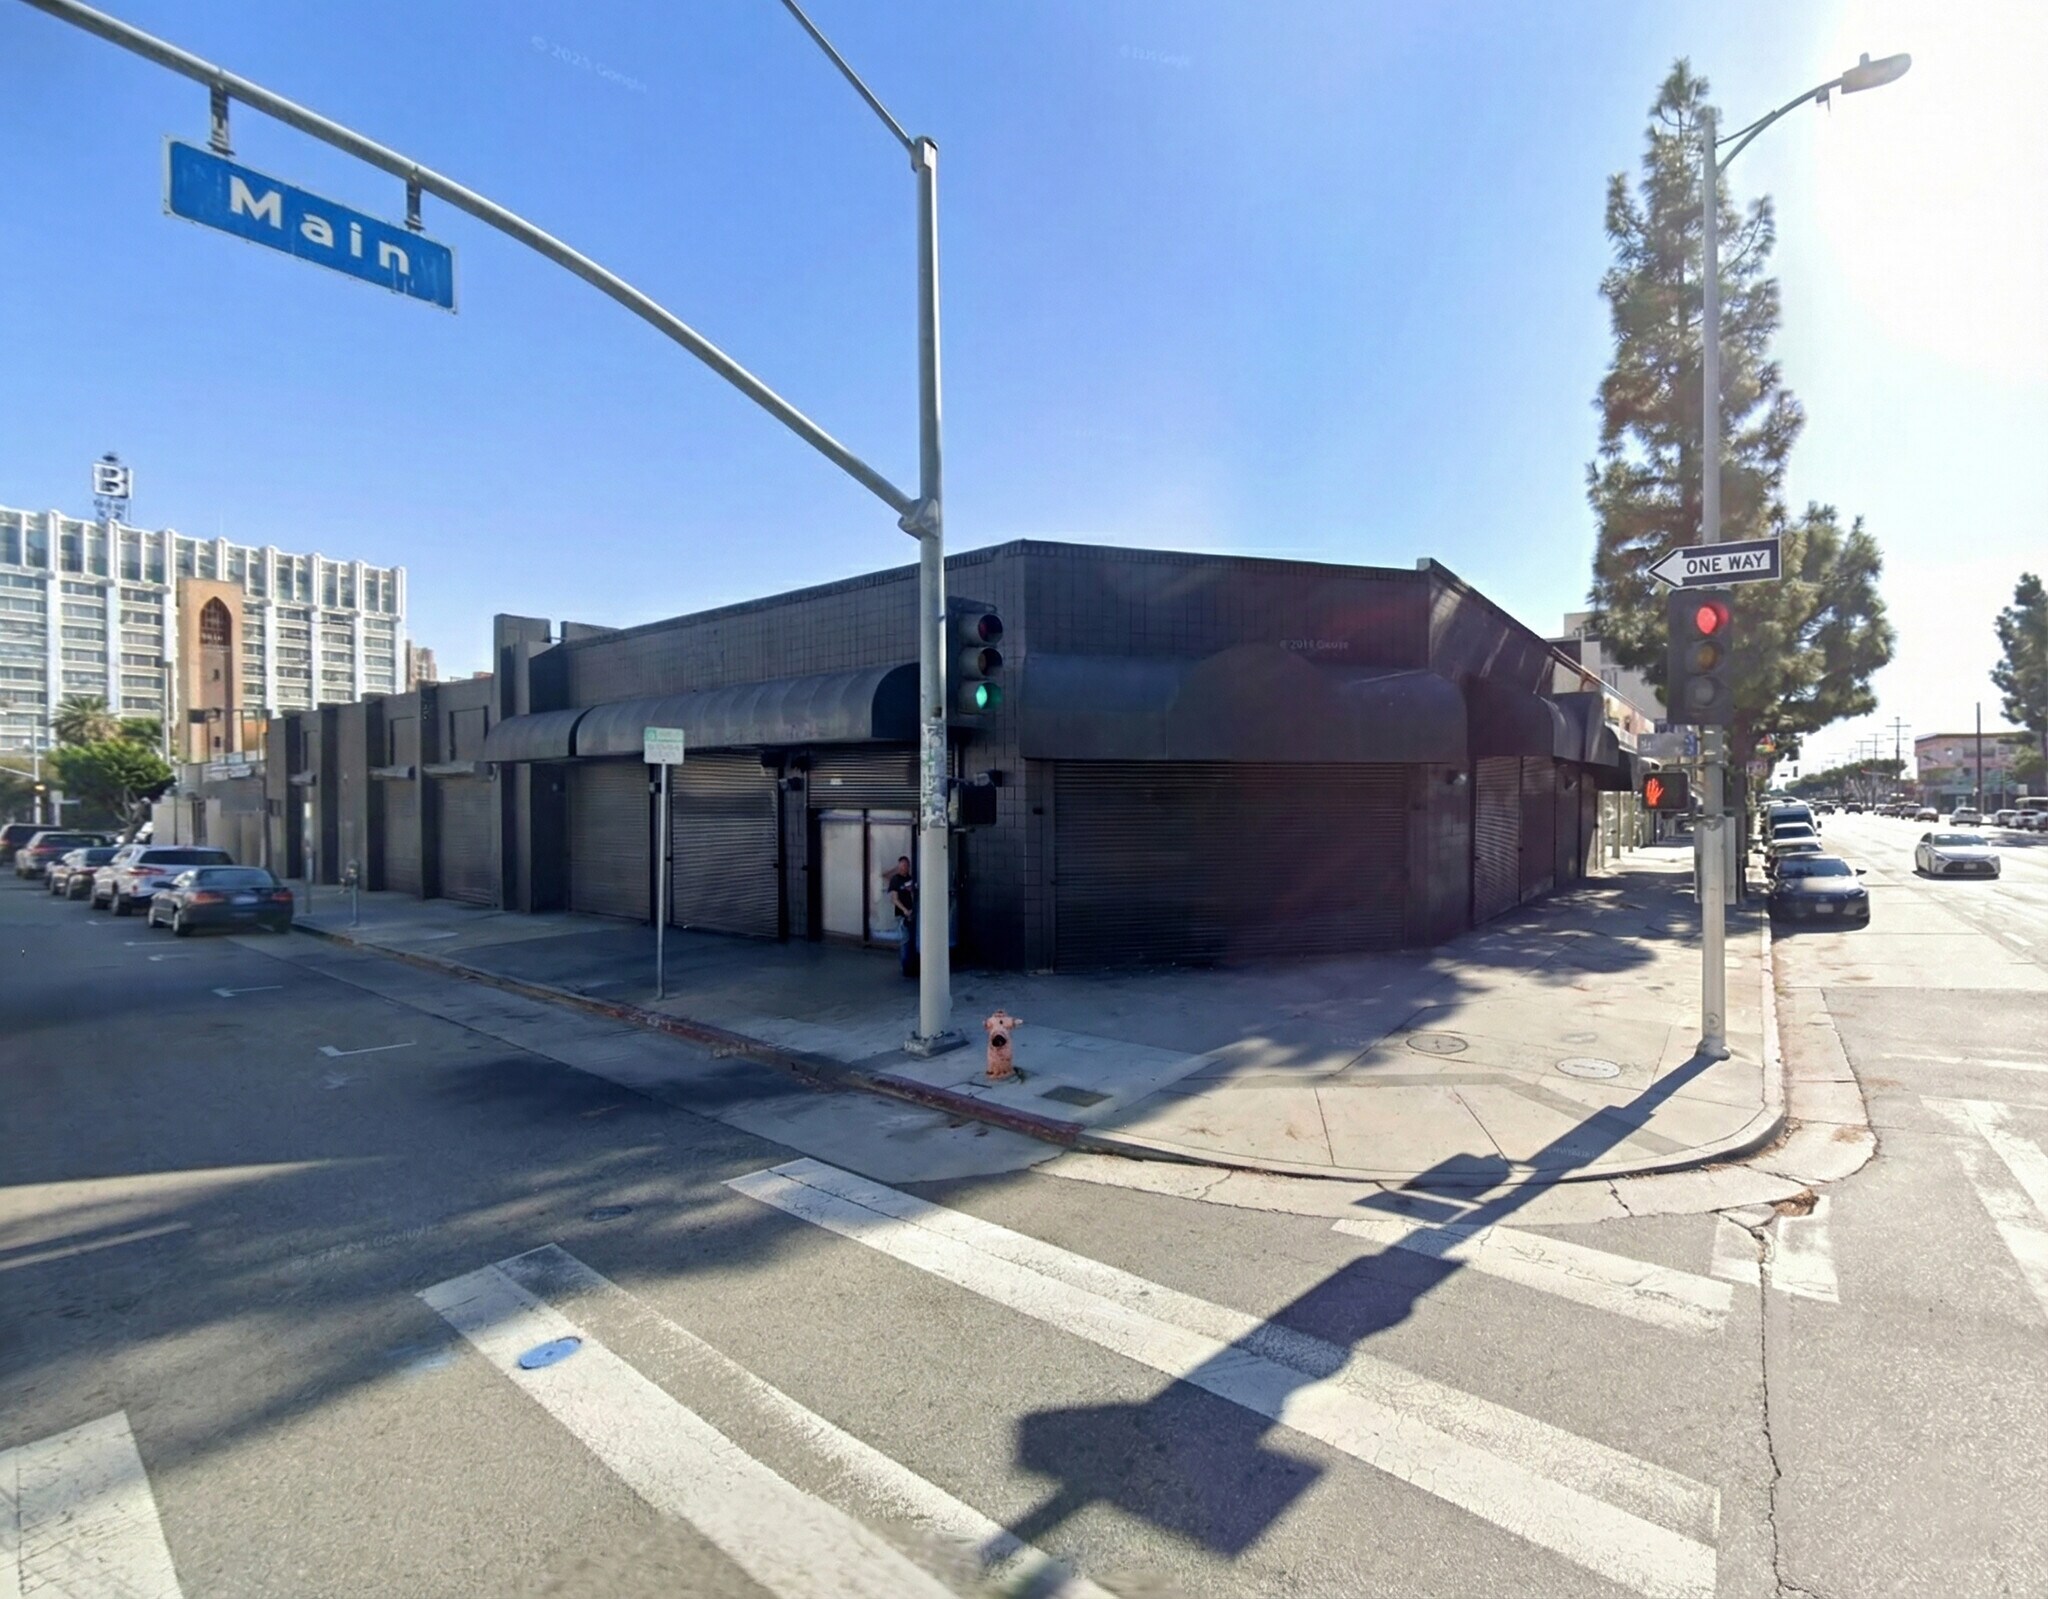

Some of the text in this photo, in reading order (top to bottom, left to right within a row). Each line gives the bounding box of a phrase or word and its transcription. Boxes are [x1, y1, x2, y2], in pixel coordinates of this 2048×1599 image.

[229, 174, 410, 276] Main
[93, 463, 126, 497] B
[1686, 552, 1766, 575] ONE WAY
